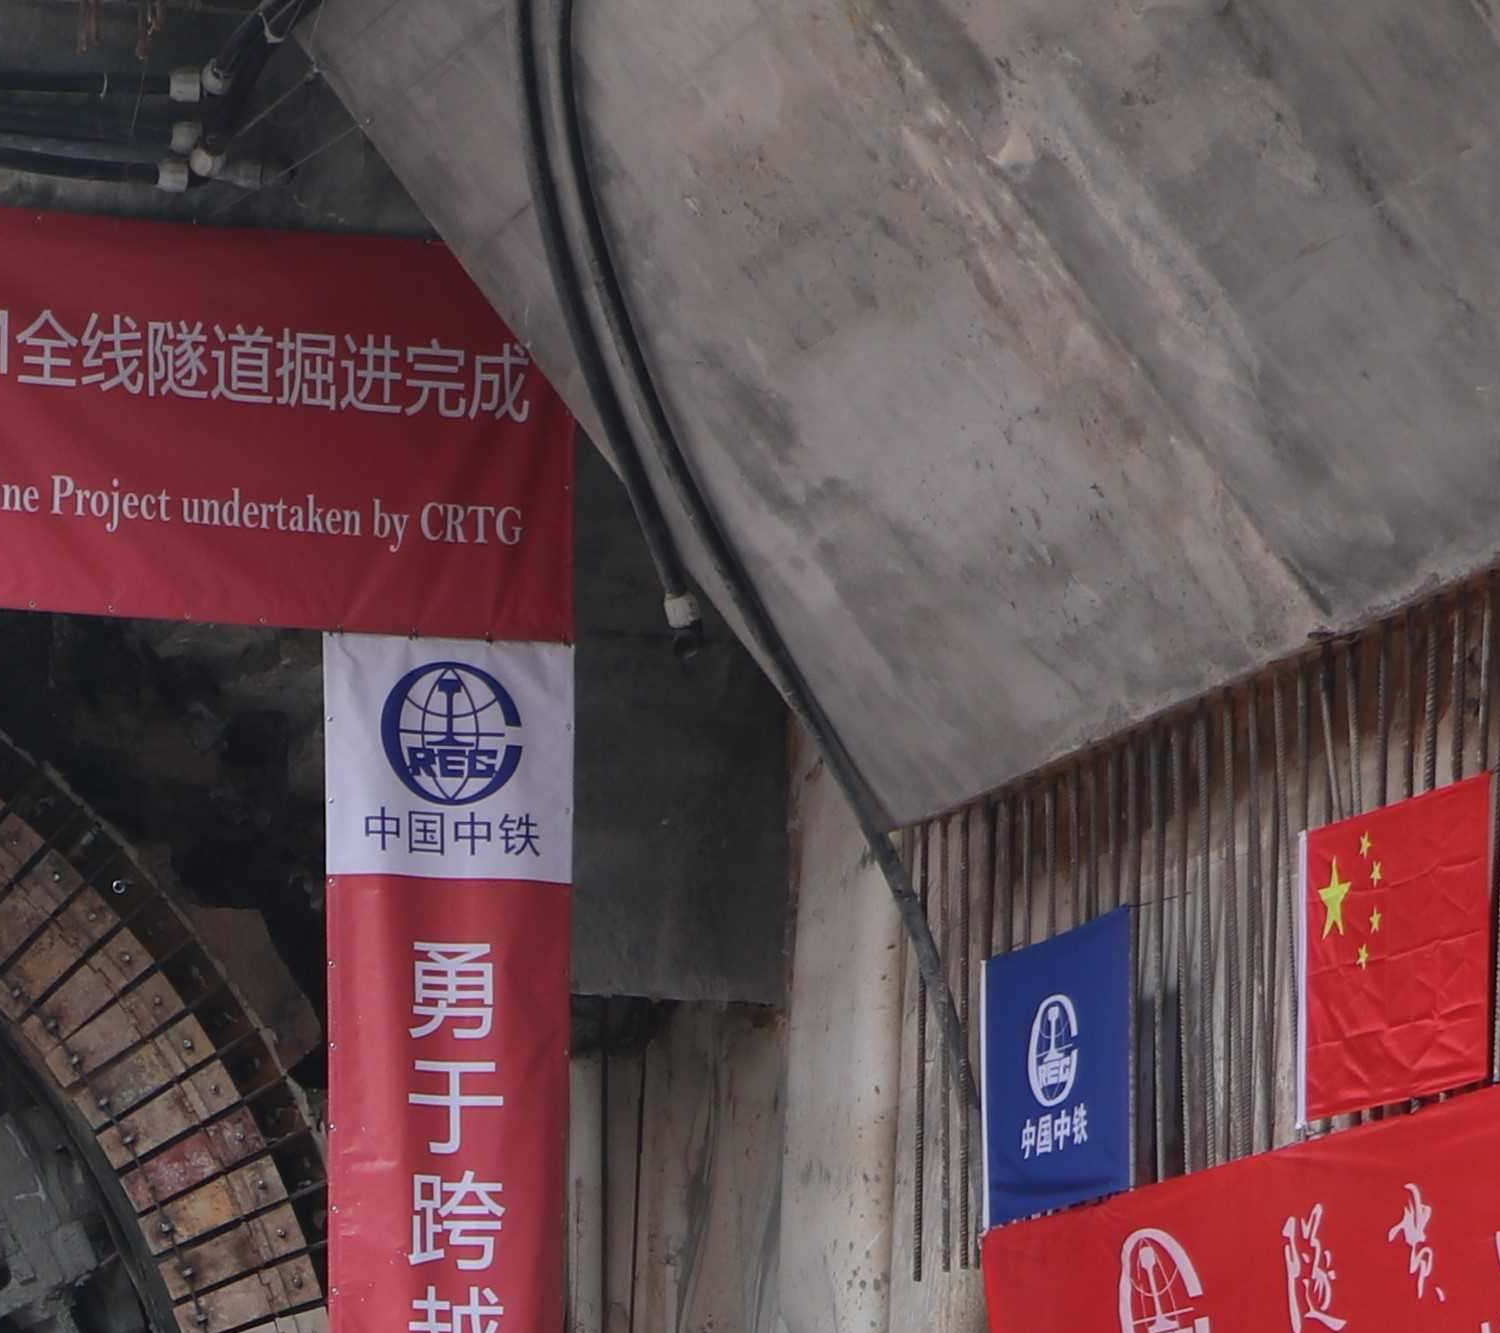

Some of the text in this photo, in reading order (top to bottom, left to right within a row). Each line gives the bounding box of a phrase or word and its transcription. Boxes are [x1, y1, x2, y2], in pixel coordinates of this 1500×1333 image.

[53, 476, 171, 533] Project
[184, 490, 362, 539] undertaken
[376, 500, 409, 553] by
[420, 502, 523, 545] CRTG
[364, 806, 541, 857] 中国中铁
[1020, 1103, 1090, 1161] 中国中铁
